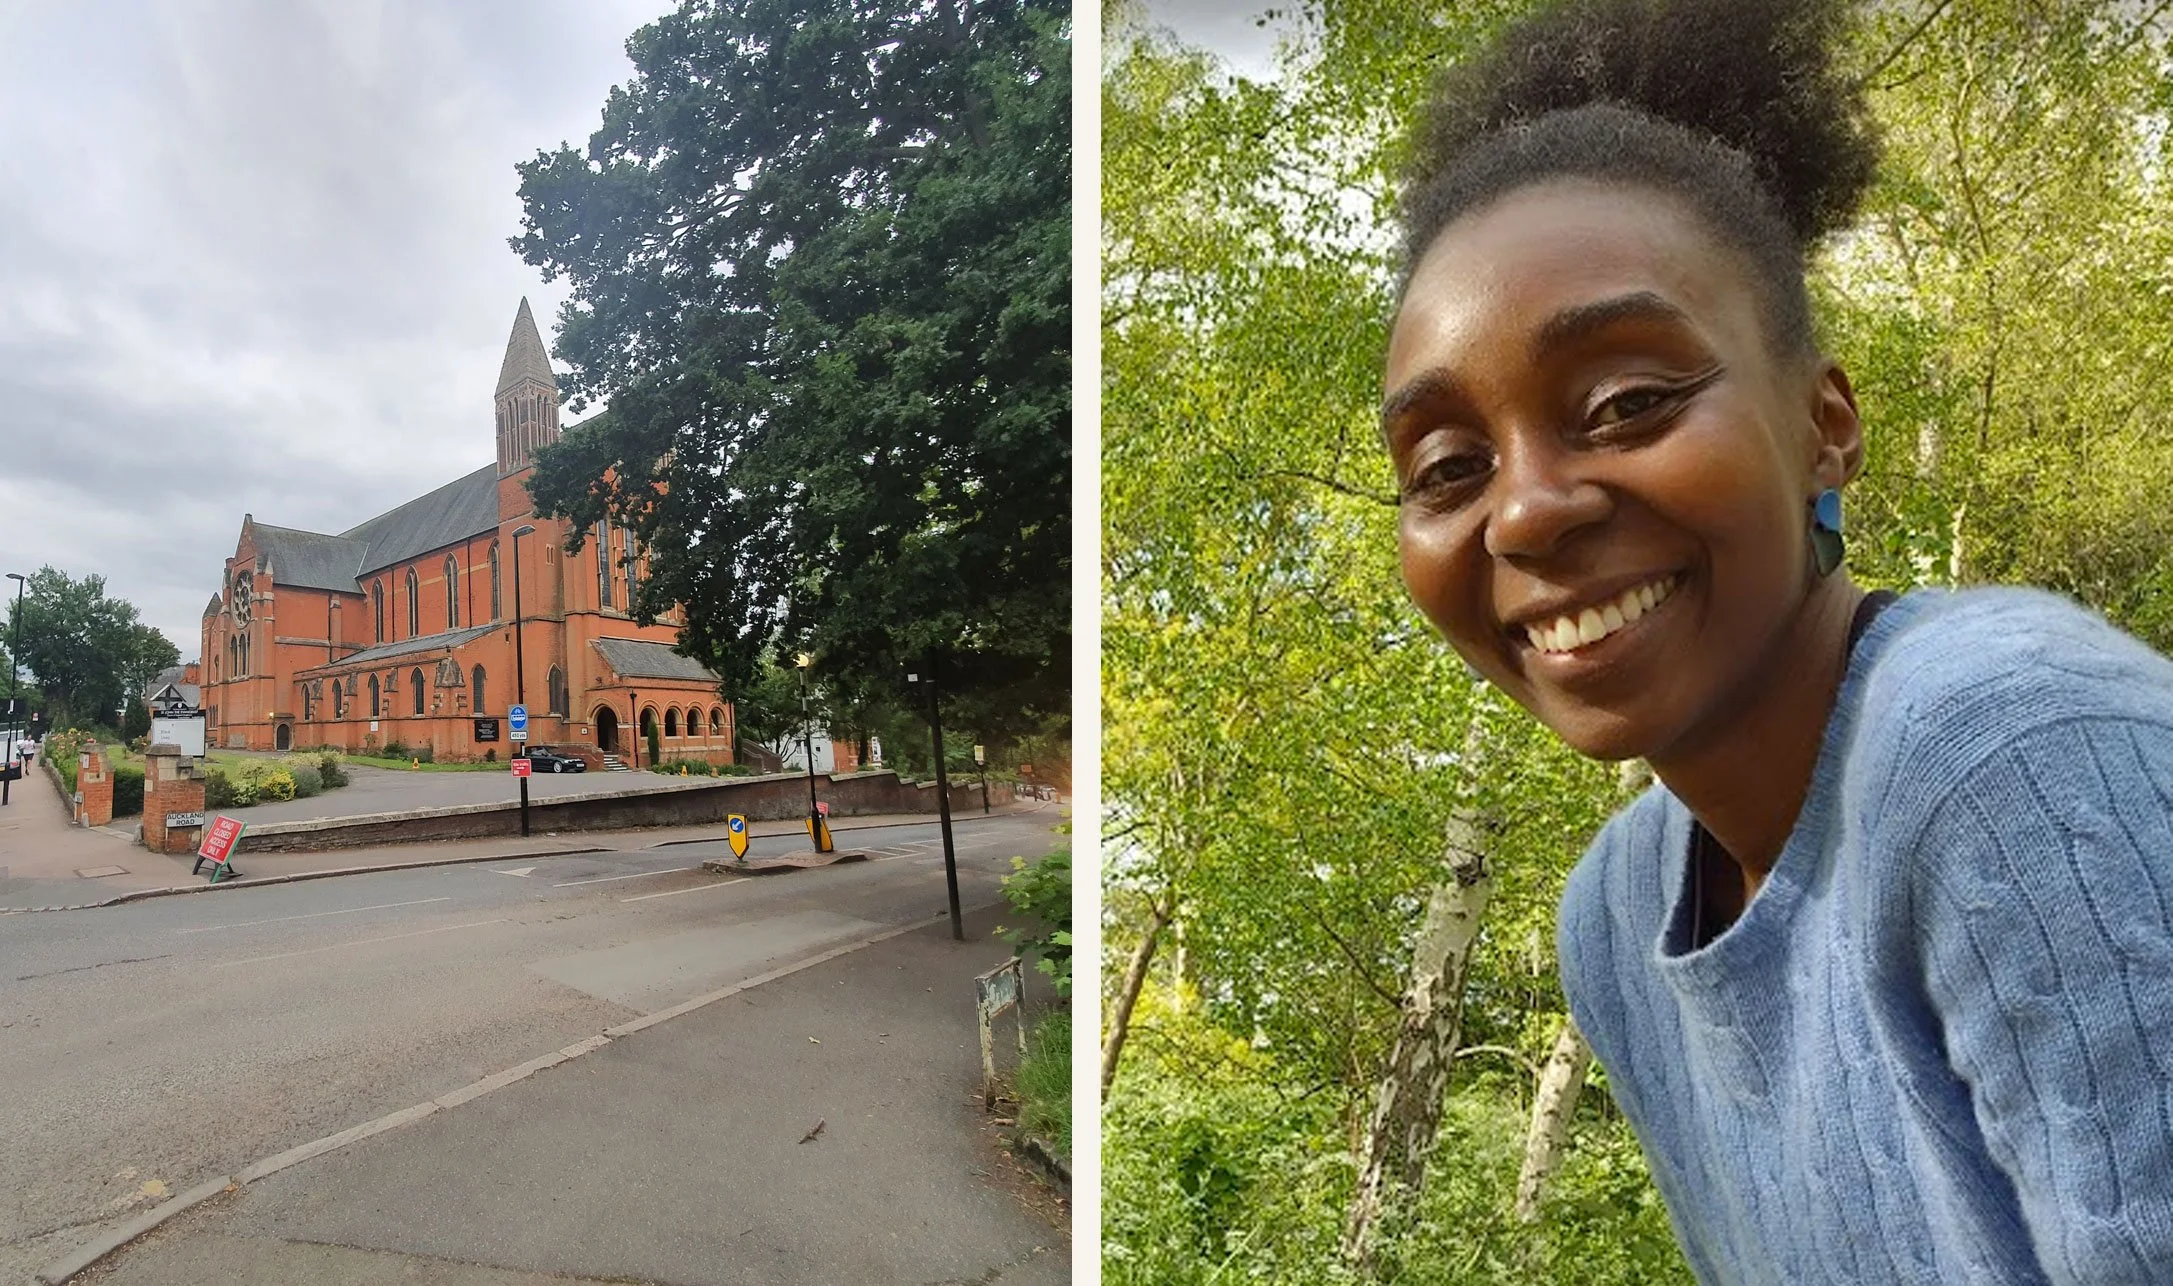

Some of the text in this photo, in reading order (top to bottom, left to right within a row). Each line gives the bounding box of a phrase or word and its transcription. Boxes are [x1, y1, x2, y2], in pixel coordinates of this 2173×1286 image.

[221, 820, 234, 830] ROAD
[213, 828, 232, 840] CLOSED
[208, 836, 228, 849] ACCESS
[207, 846, 221, 856] ONLY
